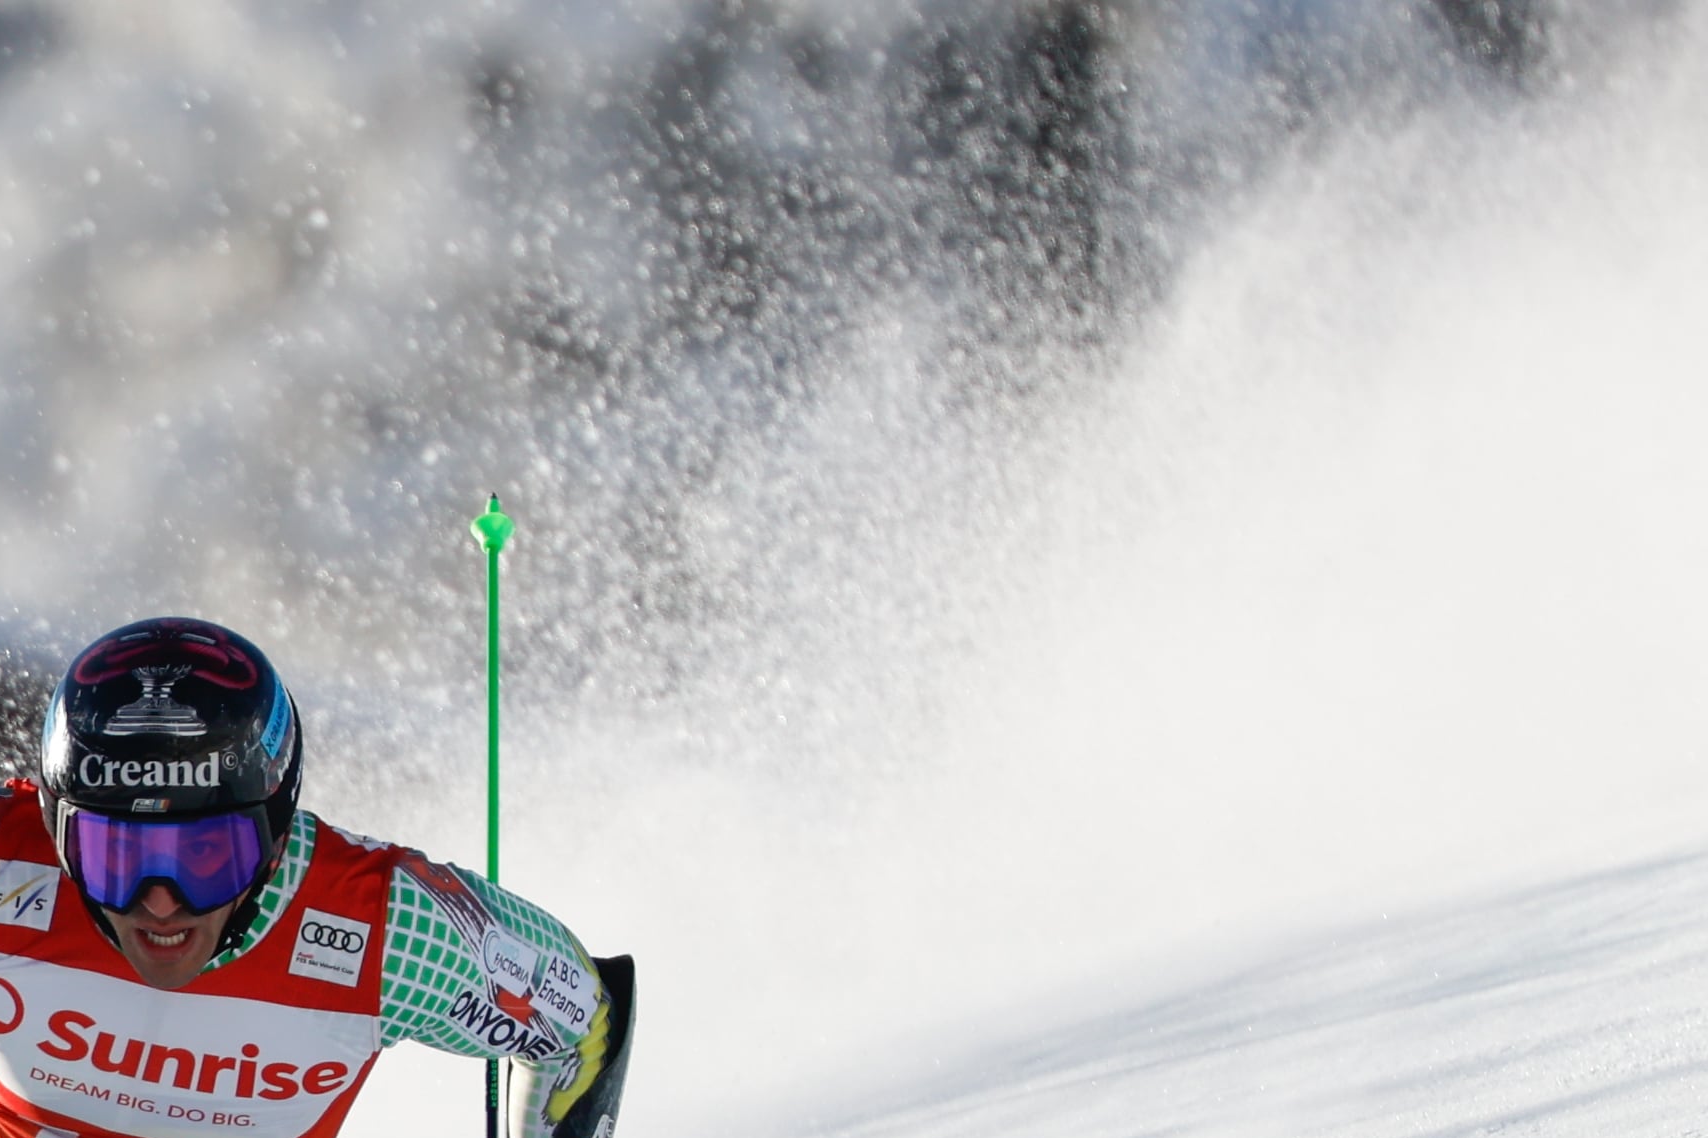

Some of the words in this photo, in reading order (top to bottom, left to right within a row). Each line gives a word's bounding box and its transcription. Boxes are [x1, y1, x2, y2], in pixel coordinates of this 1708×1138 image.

[319, 962, 341, 972] World
[341, 967, 355, 976] Cup
[494, 951, 530, 986] FACTORIA
[538, 979, 586, 1025] Encamp
[37, 1009, 349, 1101] Sunrise
[30, 1067, 110, 1102] DREAM
[117, 1092, 161, 1116] BIG.
[167, 1105, 206, 1124] DO
[212, 1110, 256, 1128] BIG.
